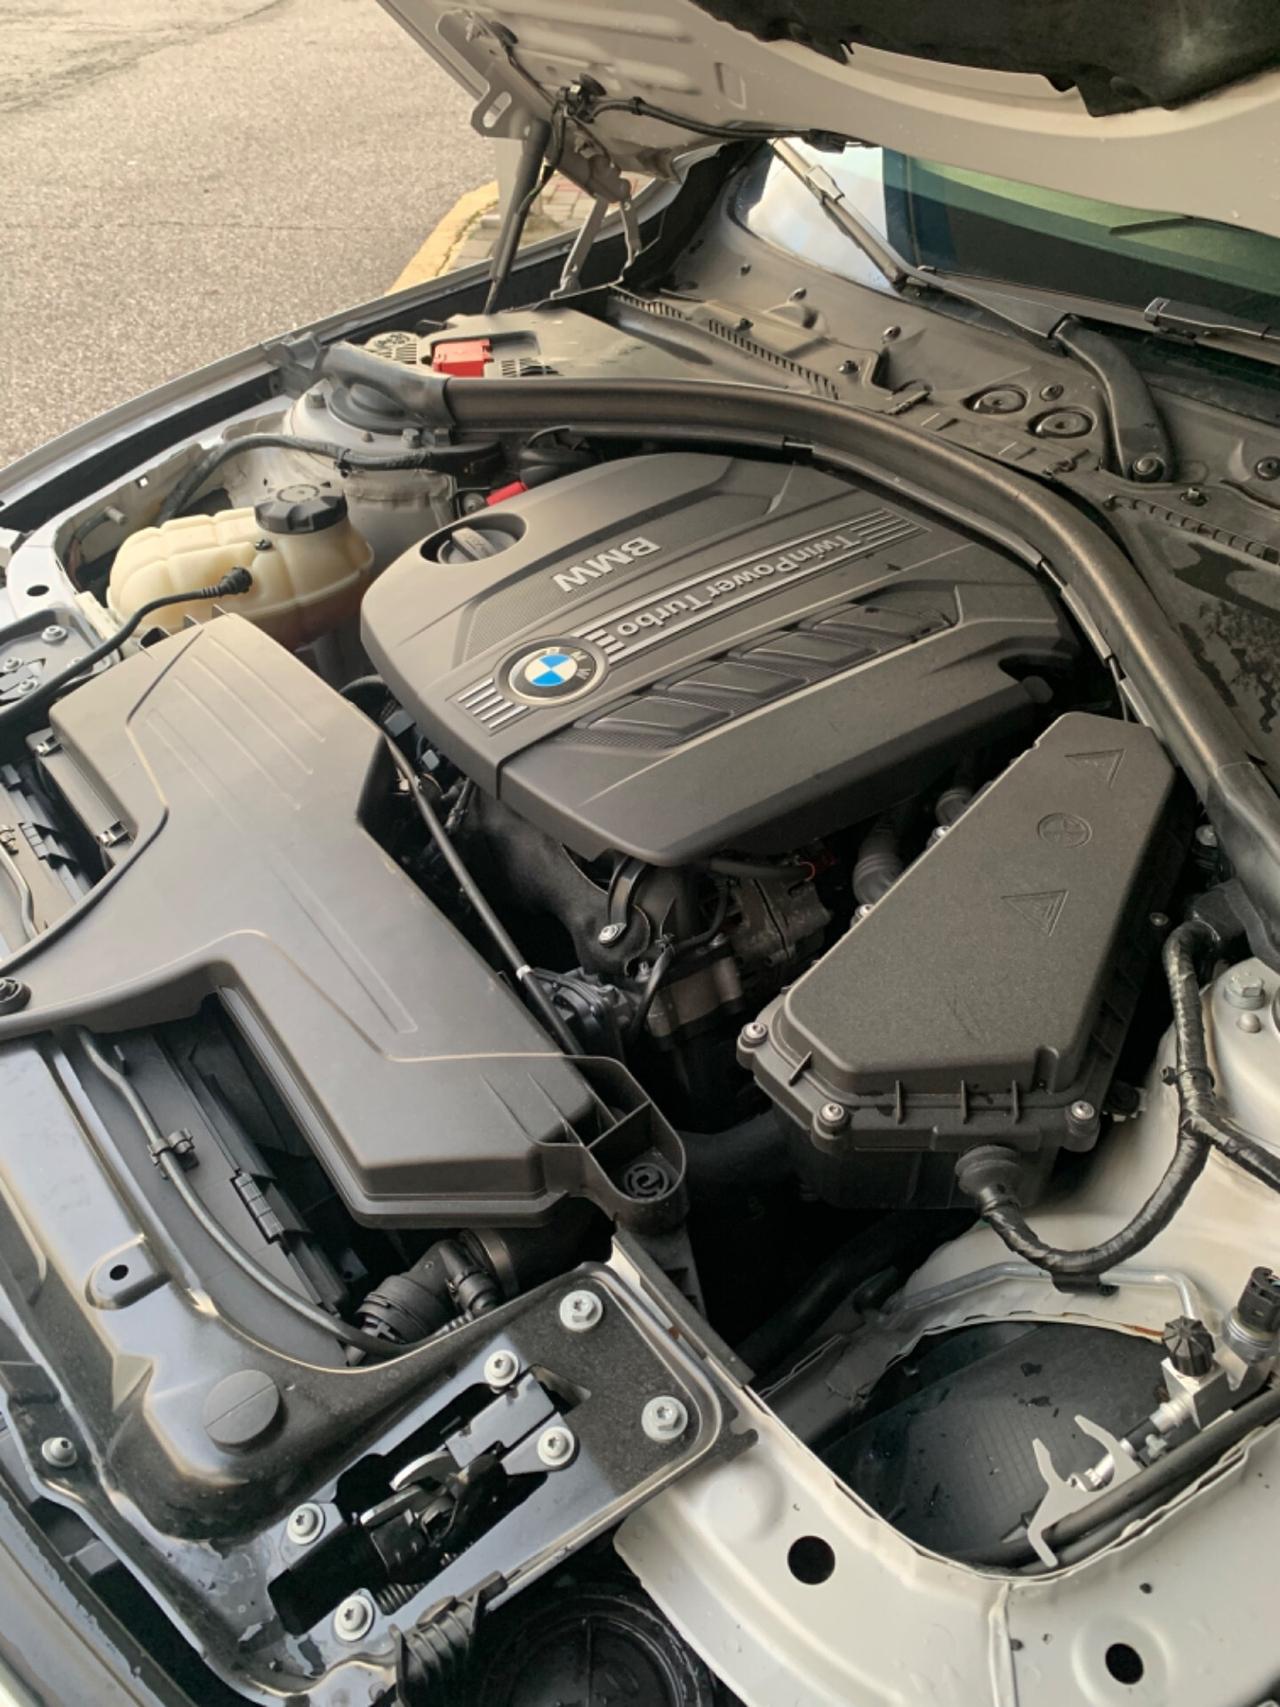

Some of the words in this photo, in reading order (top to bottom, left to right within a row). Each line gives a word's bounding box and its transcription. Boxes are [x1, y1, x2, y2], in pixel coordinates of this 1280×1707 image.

[552, 536, 661, 592] BMW
[706, 535, 861, 598] TwinPower
[617, 594, 712, 636] Turbo
